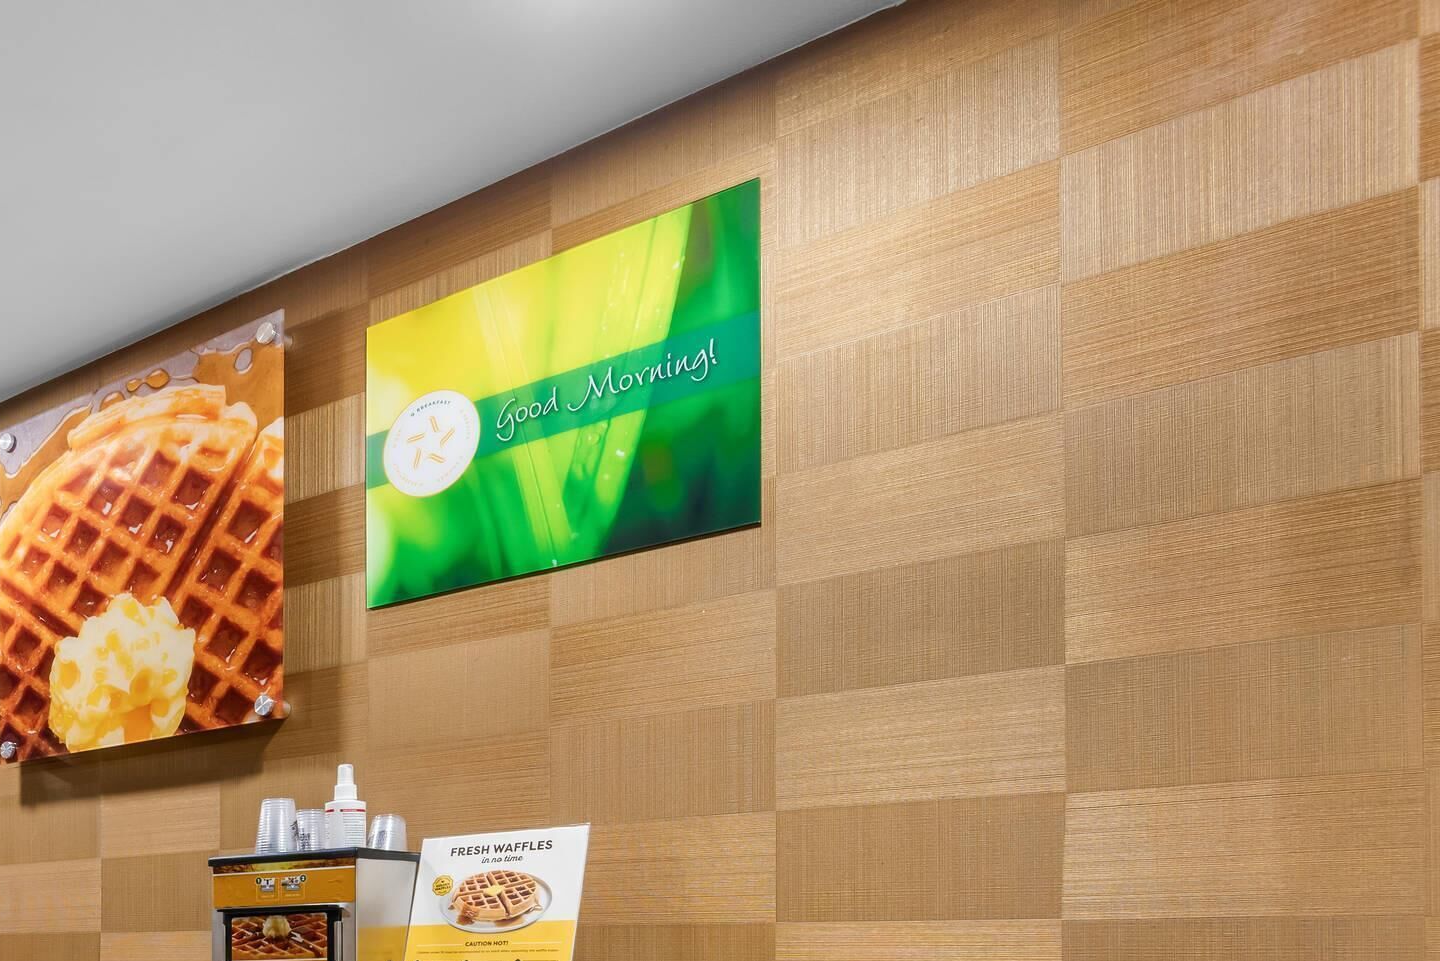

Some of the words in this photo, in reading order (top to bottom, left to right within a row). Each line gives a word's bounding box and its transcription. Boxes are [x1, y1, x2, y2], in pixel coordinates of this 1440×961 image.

[496, 386, 558, 441] Good
[567, 338, 717, 412] Morning!
[450, 845, 490, 857] FRESH
[493, 840, 553, 854] WAFFLES
[504, 854, 523, 863] time
